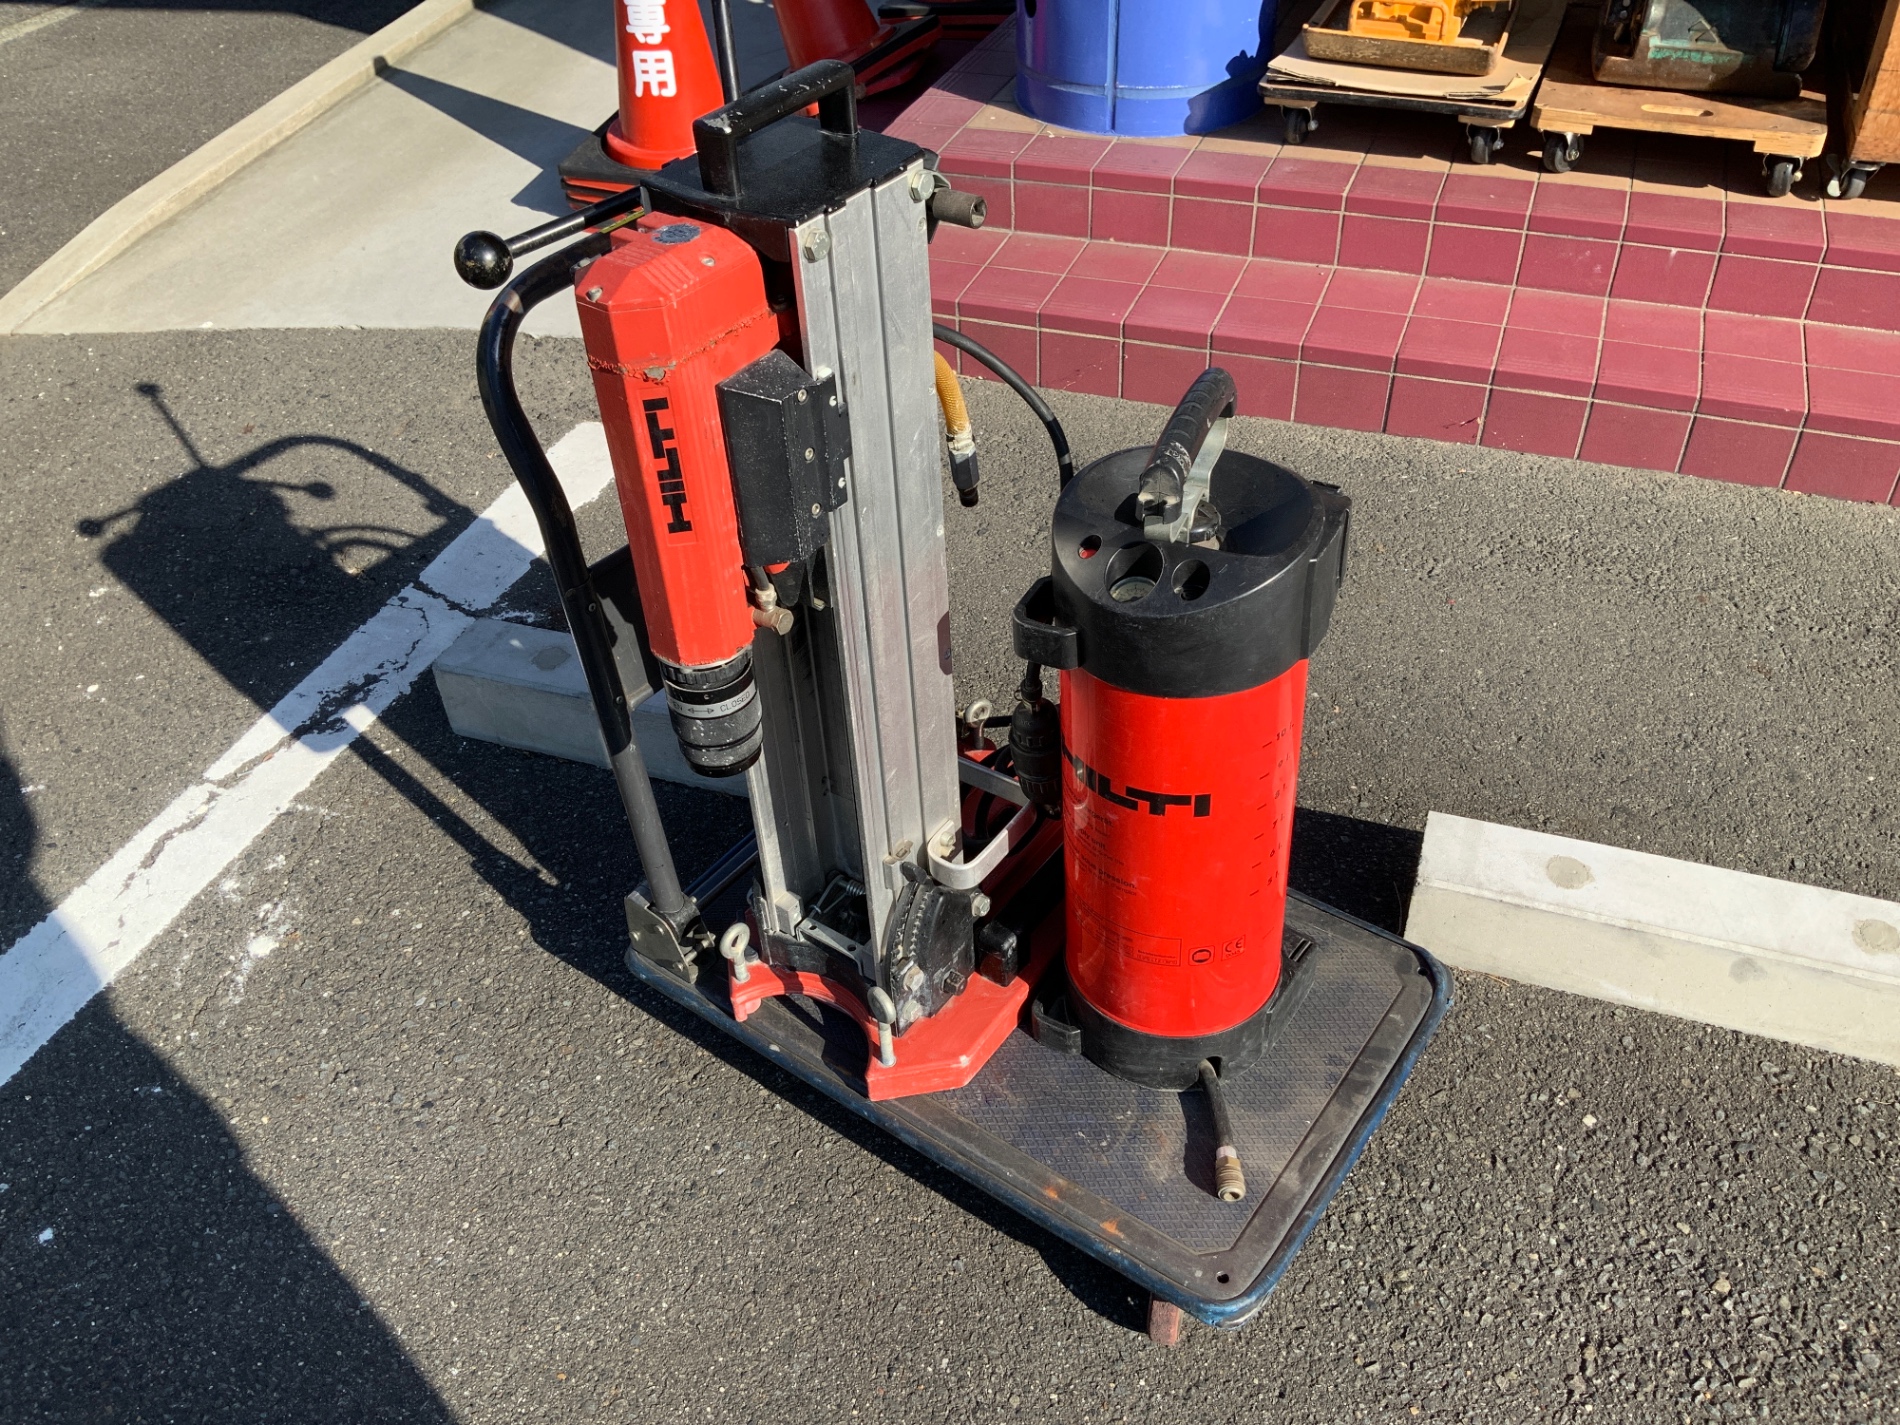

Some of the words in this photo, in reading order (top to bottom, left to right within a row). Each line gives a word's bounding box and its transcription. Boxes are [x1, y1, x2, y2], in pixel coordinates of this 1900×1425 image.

[623, 0, 677, 97] 専用
[642, 397, 693, 534] HILTI
[720, 691, 751, 713] CLOSED
[1098, 868, 1137, 889] pression.
[1225, 938, 1243, 953] CE
